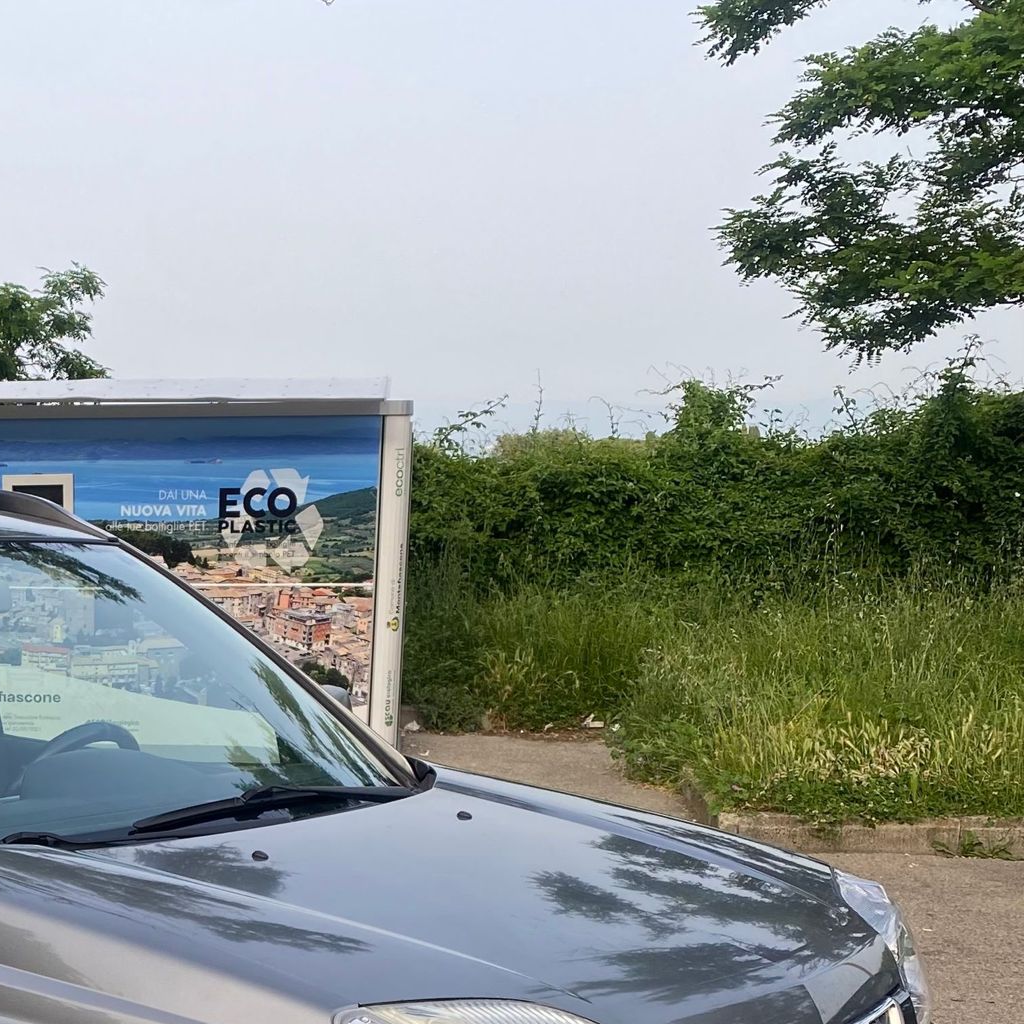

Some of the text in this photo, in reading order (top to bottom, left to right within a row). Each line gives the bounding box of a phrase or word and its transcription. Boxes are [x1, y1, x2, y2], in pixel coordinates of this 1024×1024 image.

[158, 489, 208, 500] DAI UNA
[218, 487, 297, 518] ECO
[120, 504, 207, 517] NUOVA VITA
[105, 520, 124, 532] alle
[144, 520, 185, 534] bottiglie
[218, 519, 297, 534] PLASTIC
